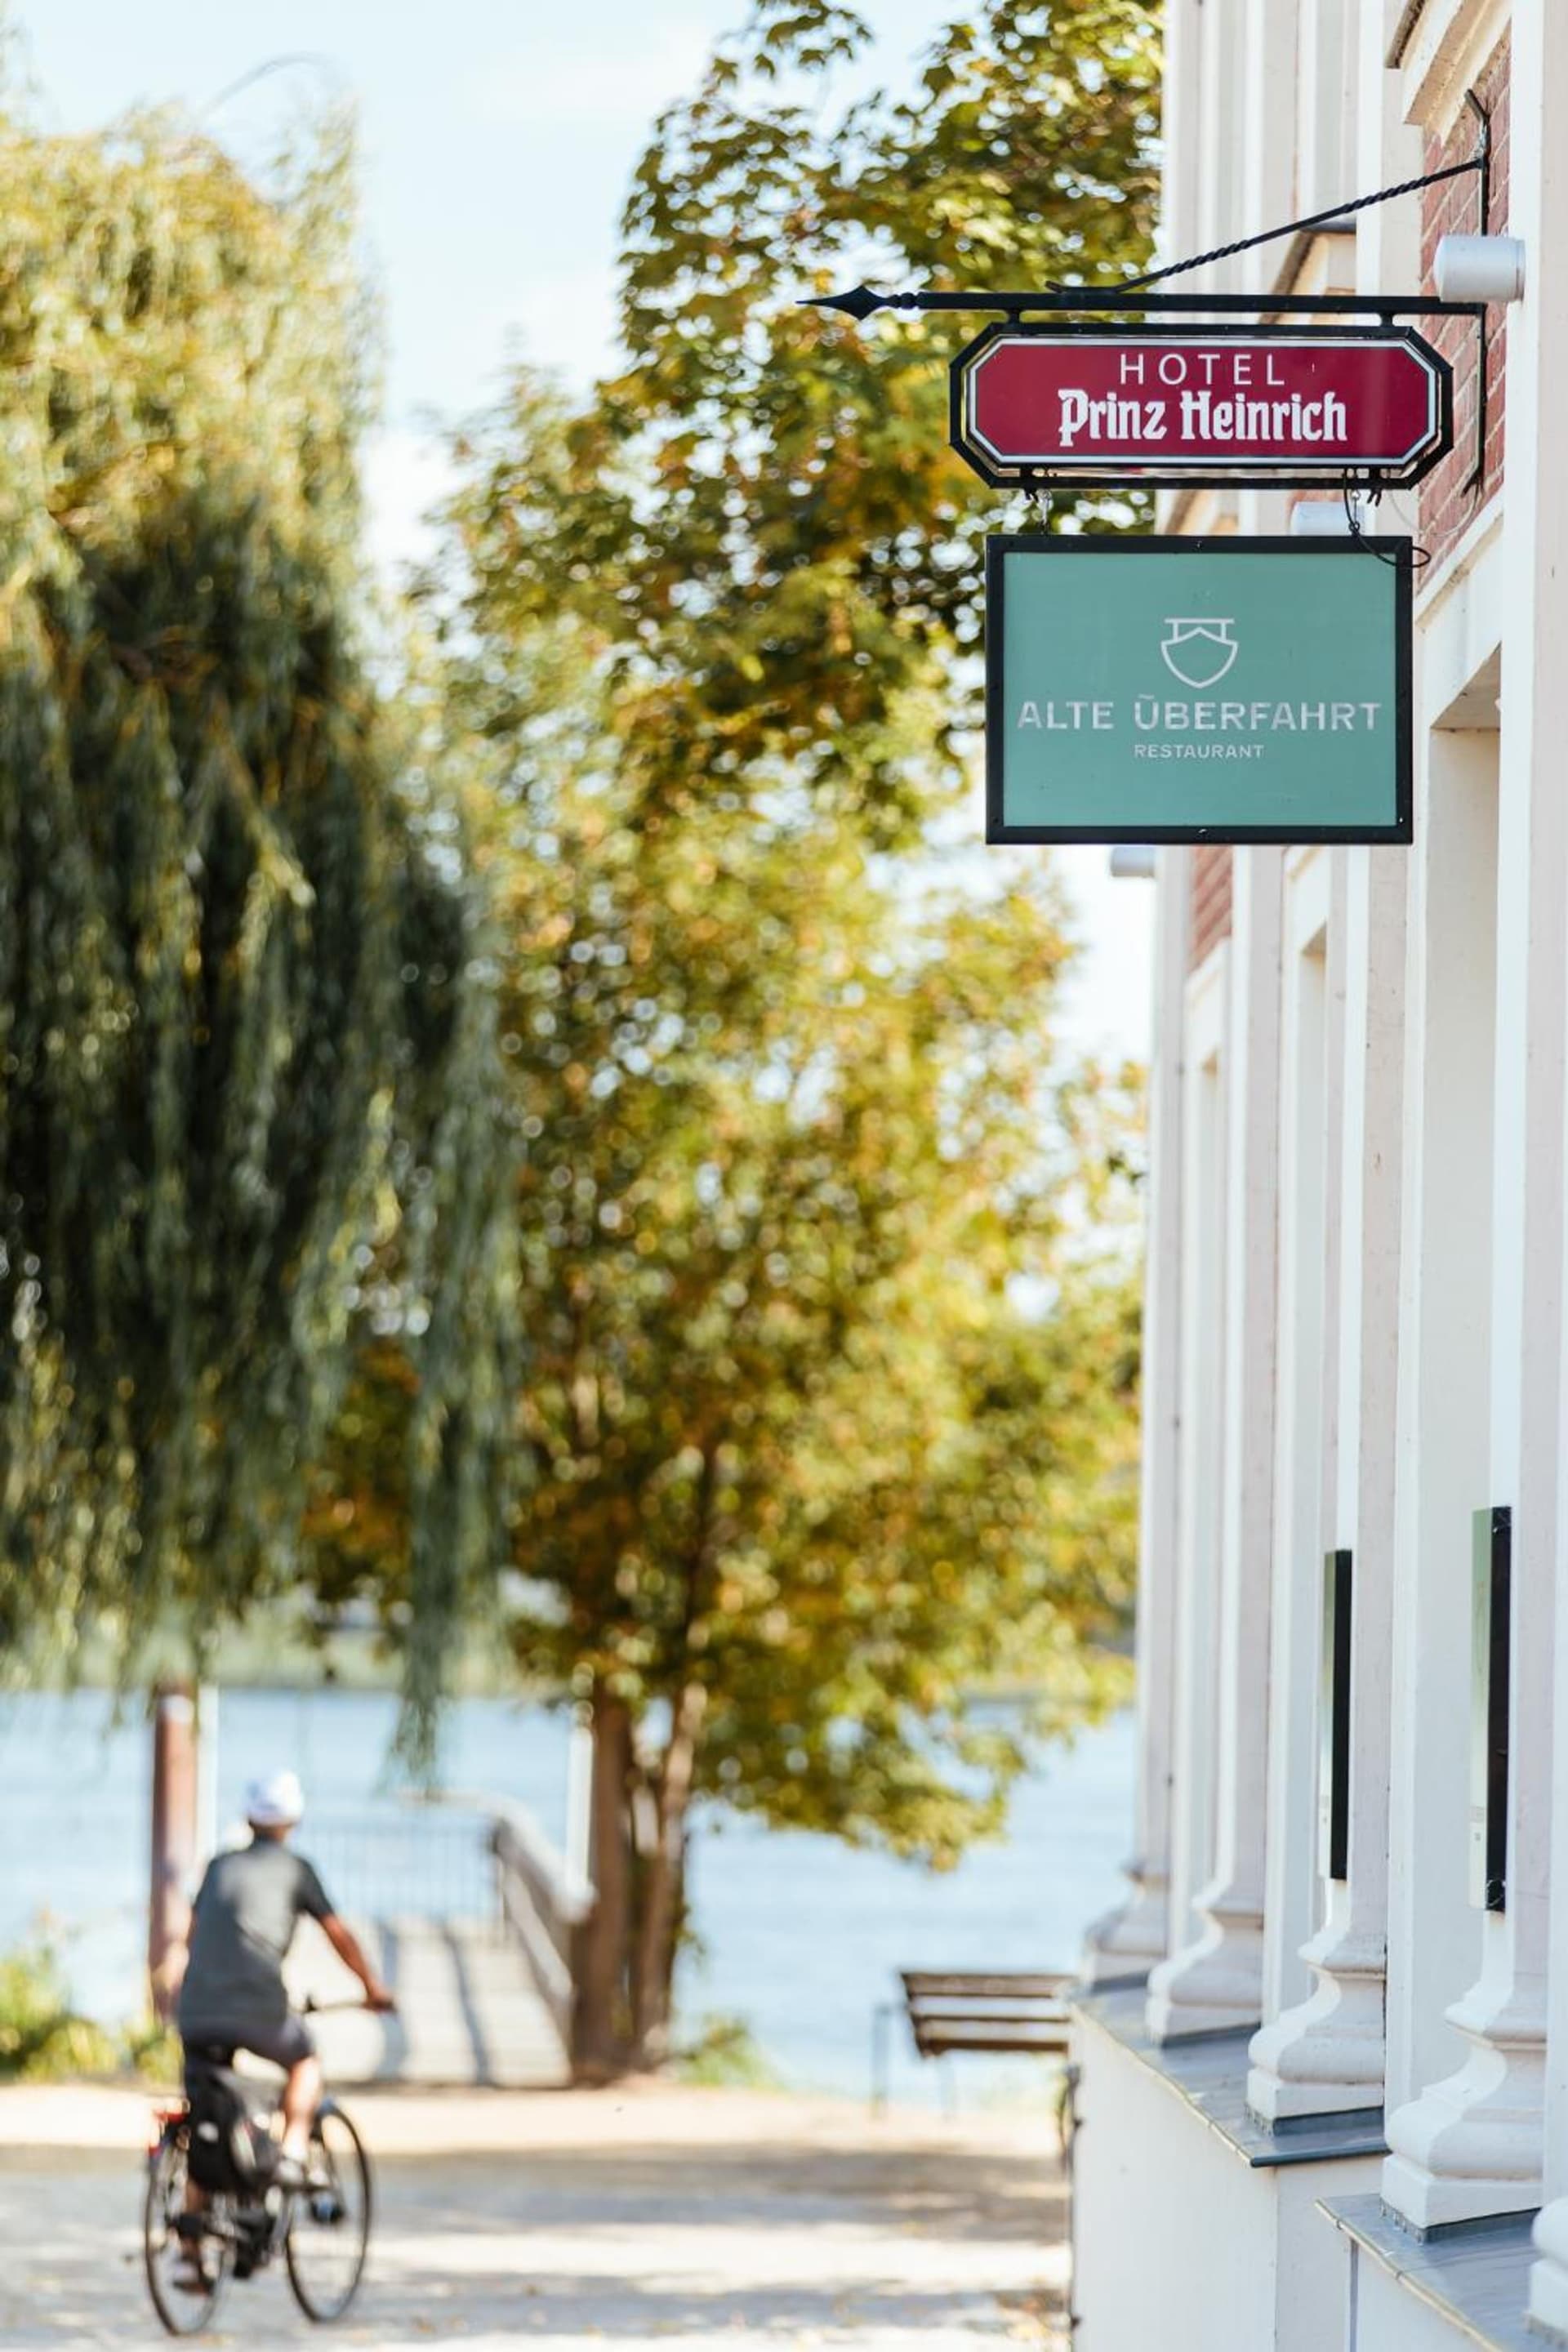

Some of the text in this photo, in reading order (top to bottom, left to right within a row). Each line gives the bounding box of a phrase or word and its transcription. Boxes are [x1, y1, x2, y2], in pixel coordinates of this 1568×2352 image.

[1120, 353, 1285, 385] HOTEL
[1058, 389, 1348, 447] Prinz Heinrich
[1017, 701, 1114, 730] ALTE
[1134, 743, 1265, 760] RESTAURANT
